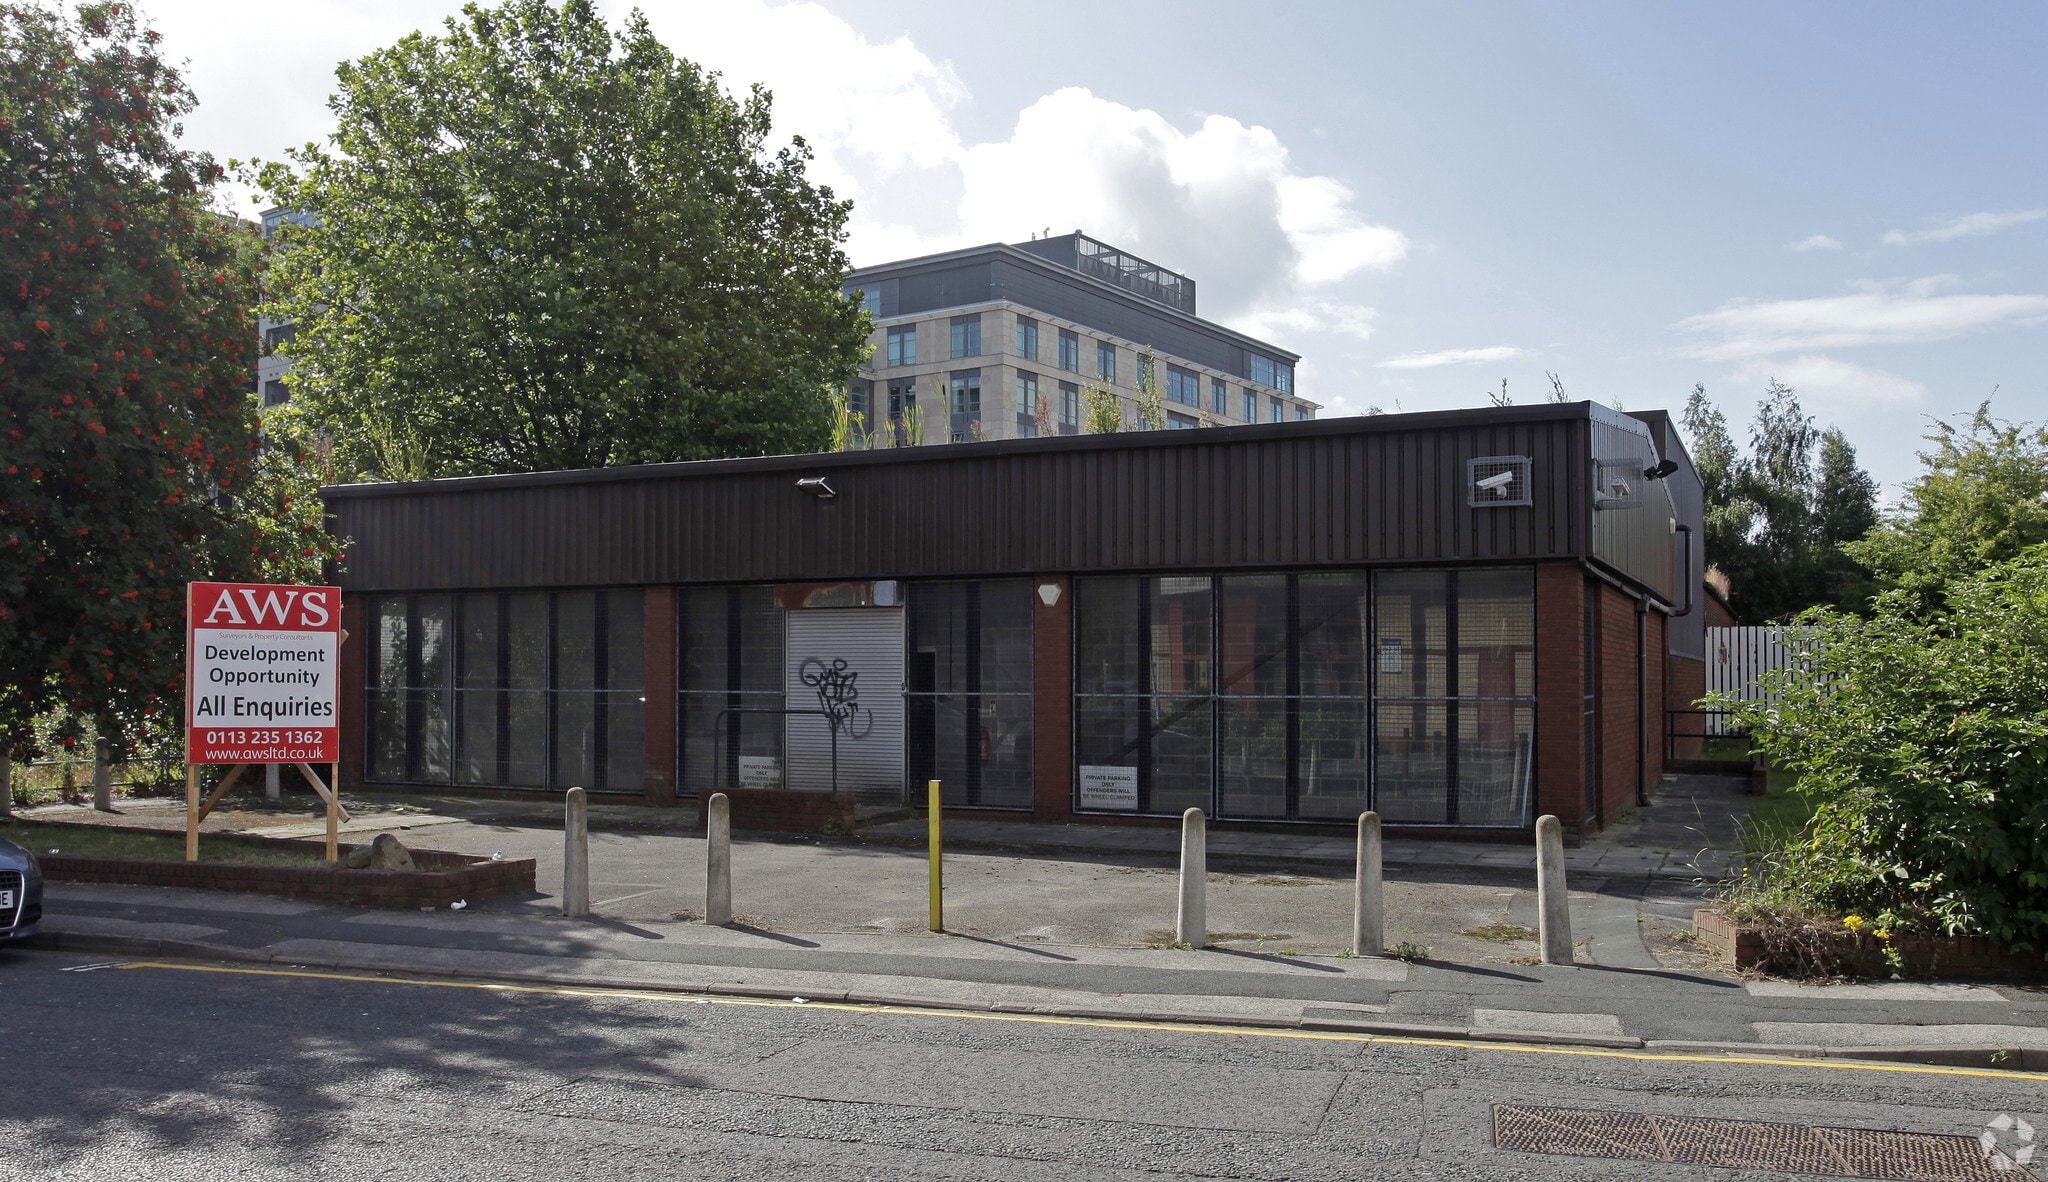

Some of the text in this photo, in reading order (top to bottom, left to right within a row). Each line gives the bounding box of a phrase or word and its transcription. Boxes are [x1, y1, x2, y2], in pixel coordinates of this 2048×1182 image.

[204, 589, 328, 626] AWS
[205, 646, 325, 664] Development
[210, 668, 319, 687] Opportunity
[198, 695, 332, 721] All Enquiries
[207, 731, 322, 744] 0113 235 1362
[205, 747, 323, 760] www.awsltd.co.uk
